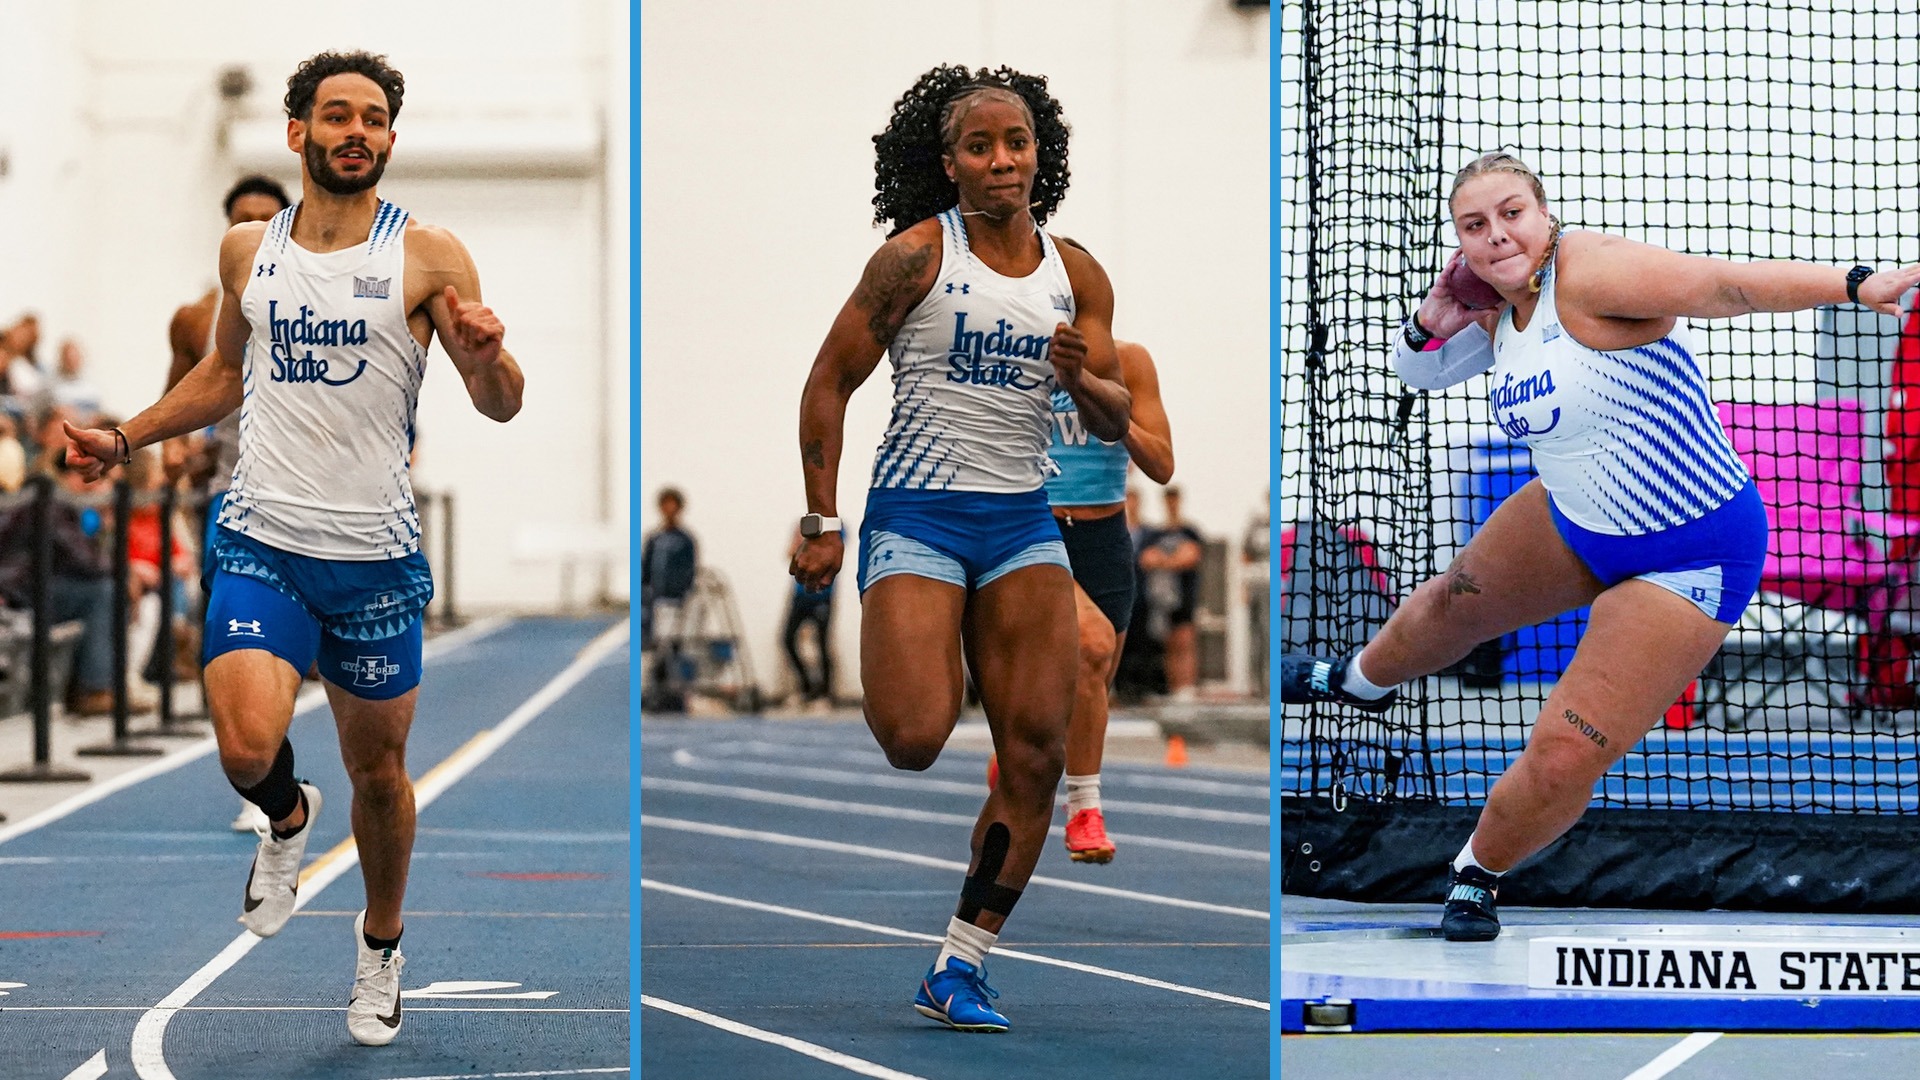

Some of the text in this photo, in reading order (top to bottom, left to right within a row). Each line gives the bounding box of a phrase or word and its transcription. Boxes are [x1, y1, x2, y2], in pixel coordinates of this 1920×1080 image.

[353, 276, 391, 296] VALLEY
[269, 300, 368, 346] Indiana
[949, 312, 1051, 361] Indian
[271, 343, 367, 386] State
[947, 353, 1054, 391] State
[1491, 369, 1556, 412] ndiana
[341, 661, 399, 675] SYCAMORES
[1312, 661, 1332, 693] NIKE
[1562, 709, 1608, 748] SONDER
[1448, 884, 1486, 903] NIKE
[1556, 947, 1920, 991] INDIANA STATE
